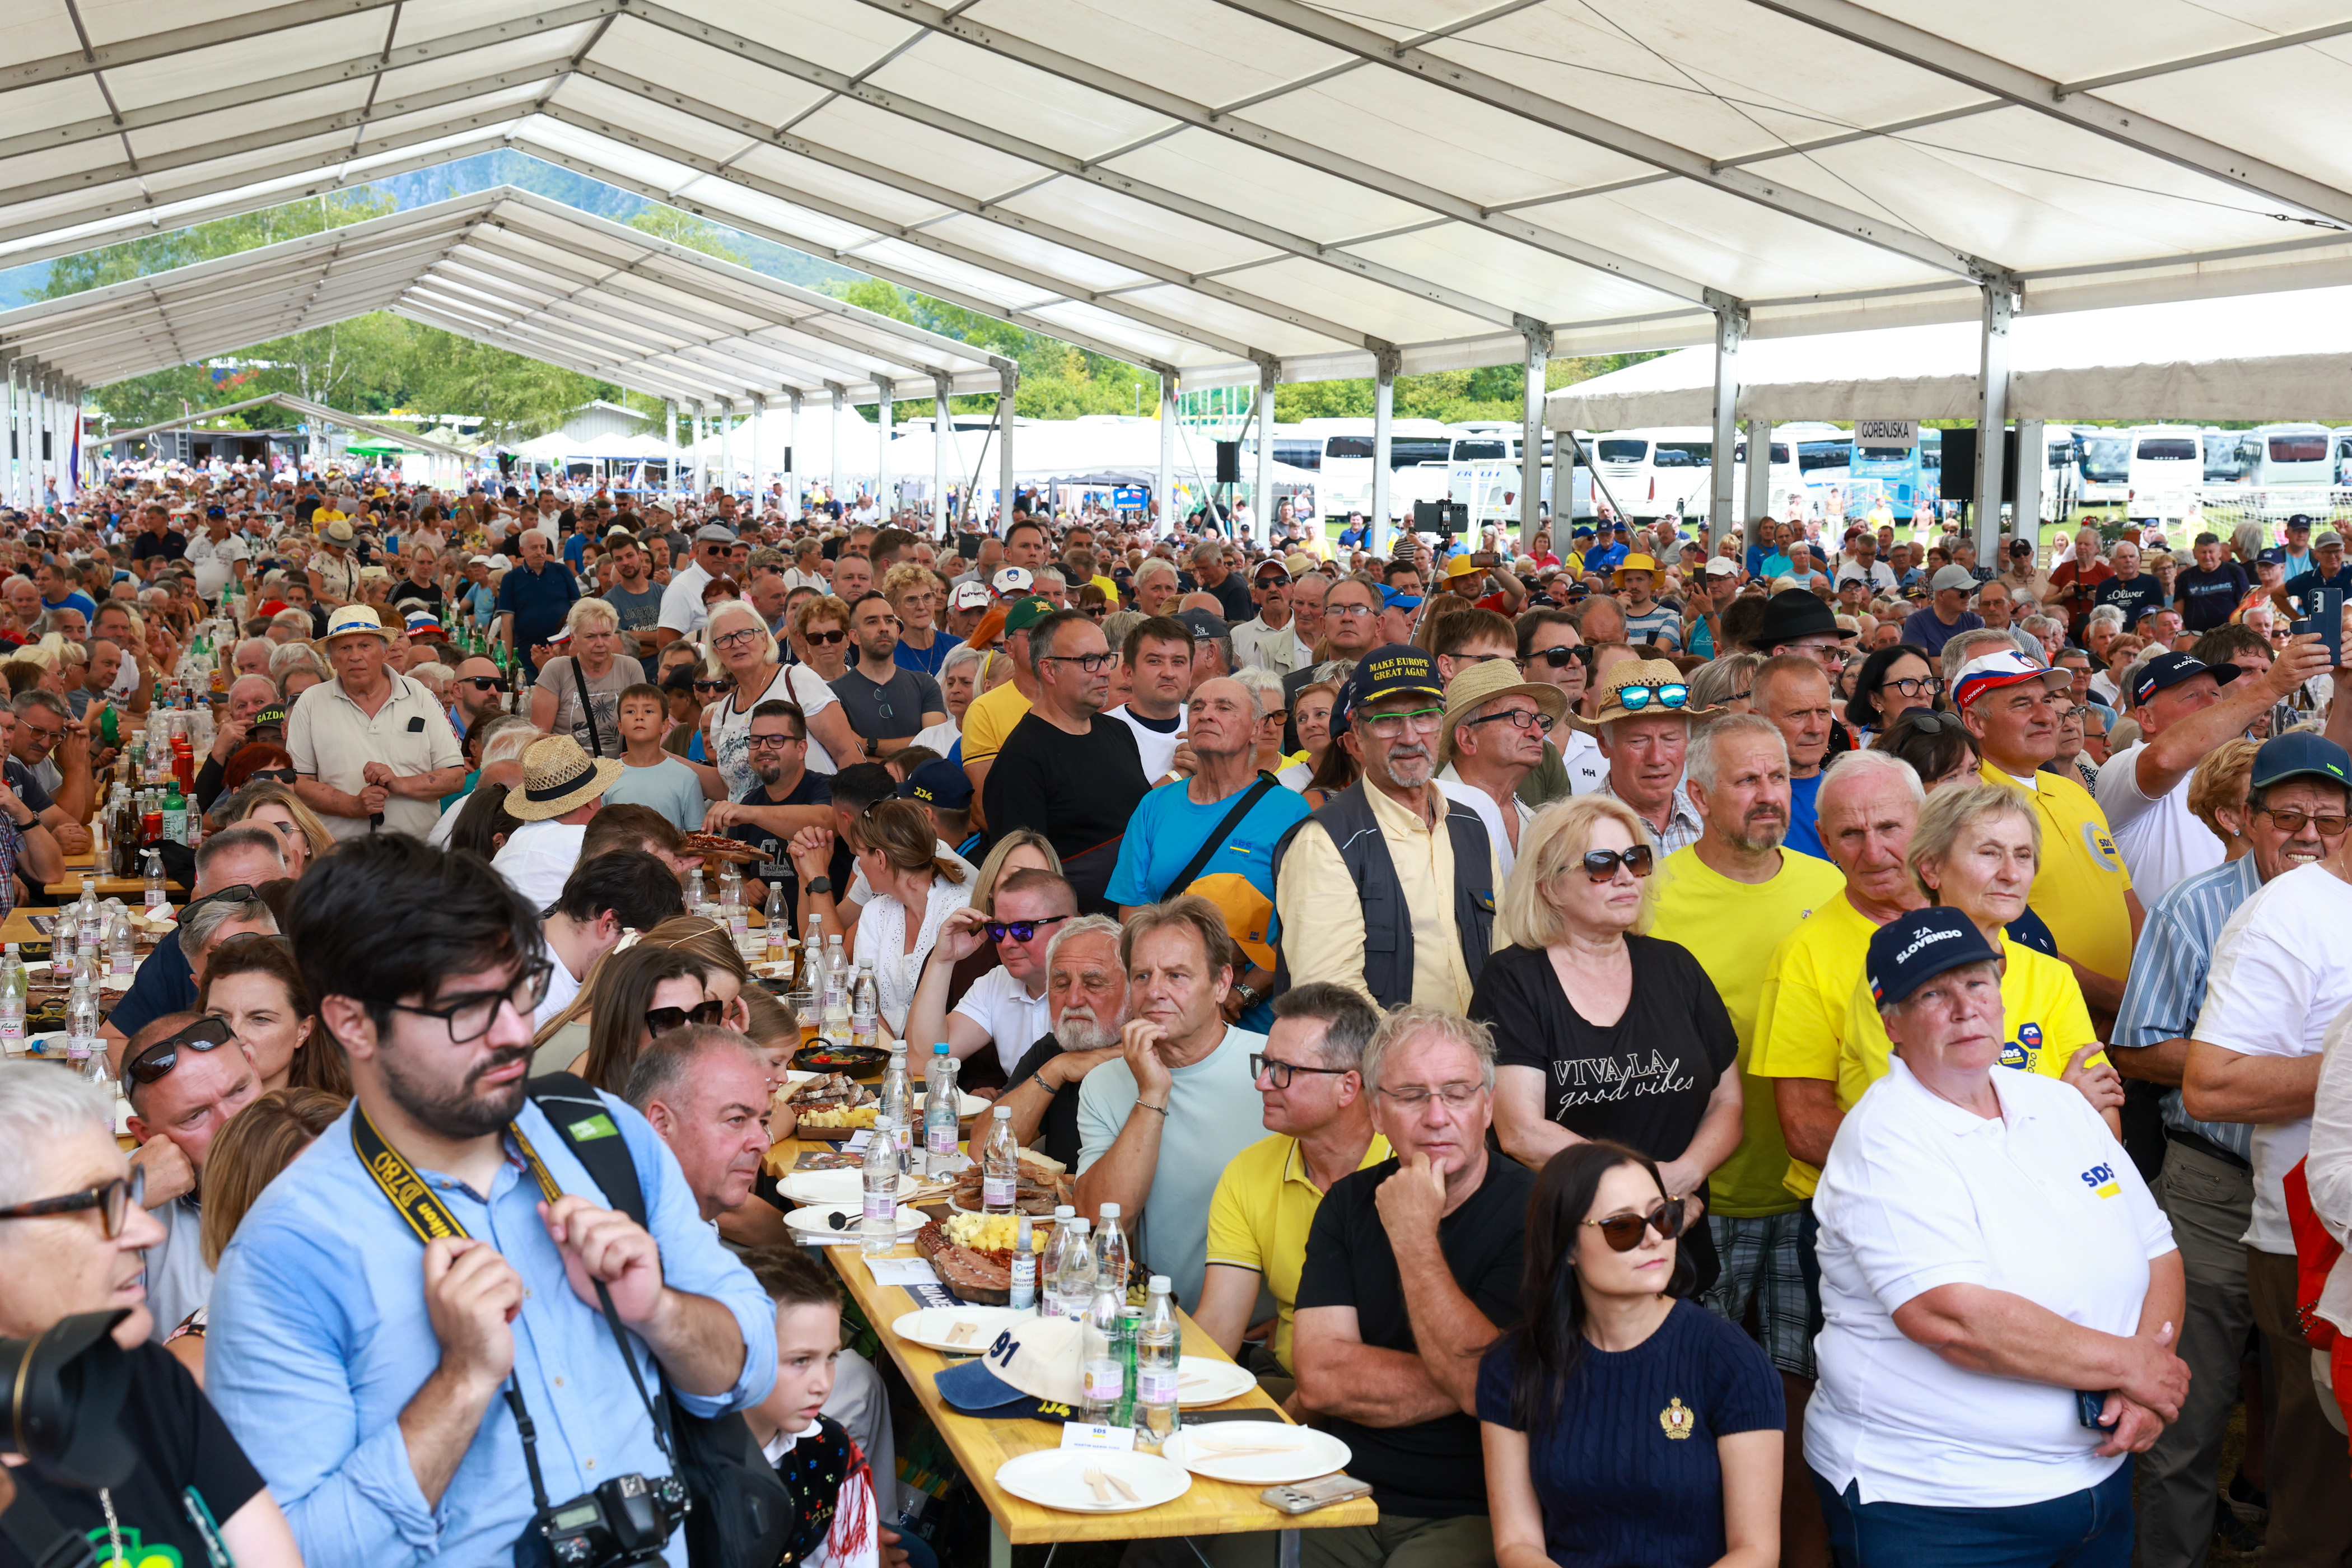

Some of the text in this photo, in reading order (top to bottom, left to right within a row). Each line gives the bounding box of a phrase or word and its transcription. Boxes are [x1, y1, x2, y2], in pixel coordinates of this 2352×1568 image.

[1862, 422, 1909, 438] GORENJSKA
[2107, 589, 2144, 601] s.Oliver
[637, 615, 659, 627] JON
[407, 627, 424, 636] NIJA
[1369, 657, 1429, 672] MAKE EUROPE
[1374, 667, 1427, 681] GREAT AGAIN
[1964, 684, 1986, 703] SLOVENIJA
[257, 711, 284, 724] GAZDA
[1582, 768, 1596, 777] HH
[913, 786, 933, 801] JJ4
[1231, 838, 1251, 849] SDS
[1912, 926, 1933, 939] ZA
[1896, 930, 1962, 964] SLOVENIJO
[2000, 1048, 2021, 1058] SDS
[1553, 1049, 1670, 1086] VIVA LA
[1556, 1058, 1694, 1121] good vibes
[373, 1151, 424, 1208] D780
[2081, 1162, 2115, 1187] SDS
[990, 1328, 1020, 1368] 91
